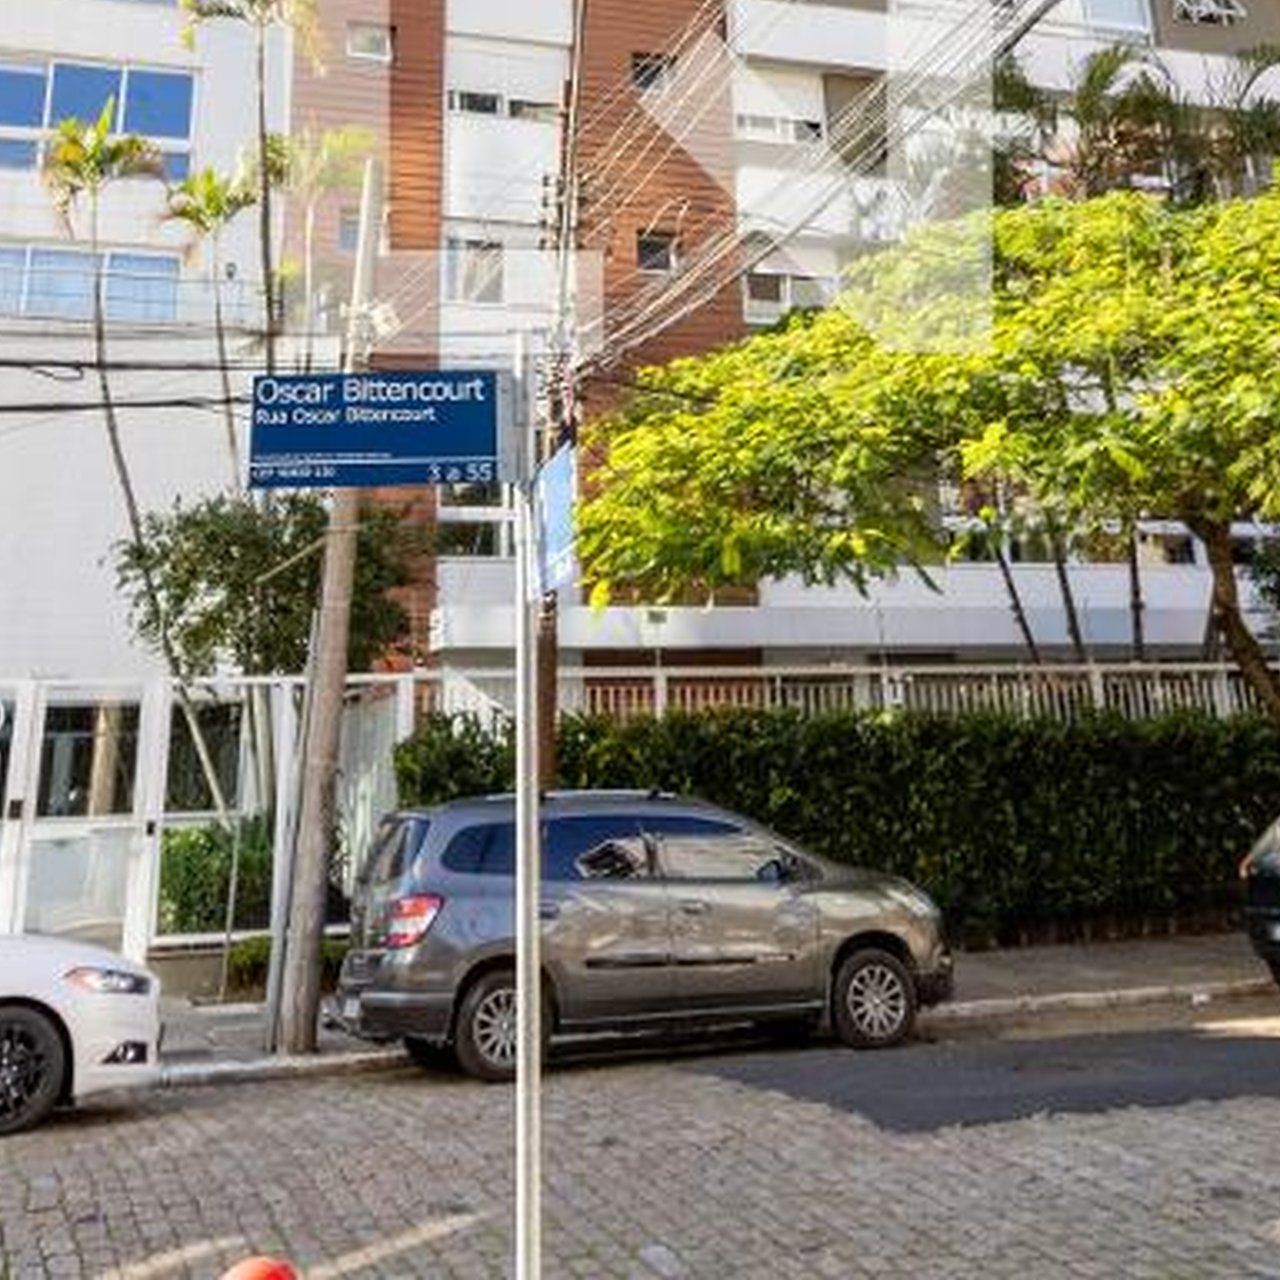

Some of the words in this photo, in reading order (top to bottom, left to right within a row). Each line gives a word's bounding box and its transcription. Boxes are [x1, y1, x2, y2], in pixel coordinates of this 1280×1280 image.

[257, 378, 334, 405] Oscar
[342, 377, 485, 402] Bittencourt
[255, 408, 288, 425] Rua
[292, 407, 341, 424] Oscar
[345, 406, 437, 422] Bittencourt
